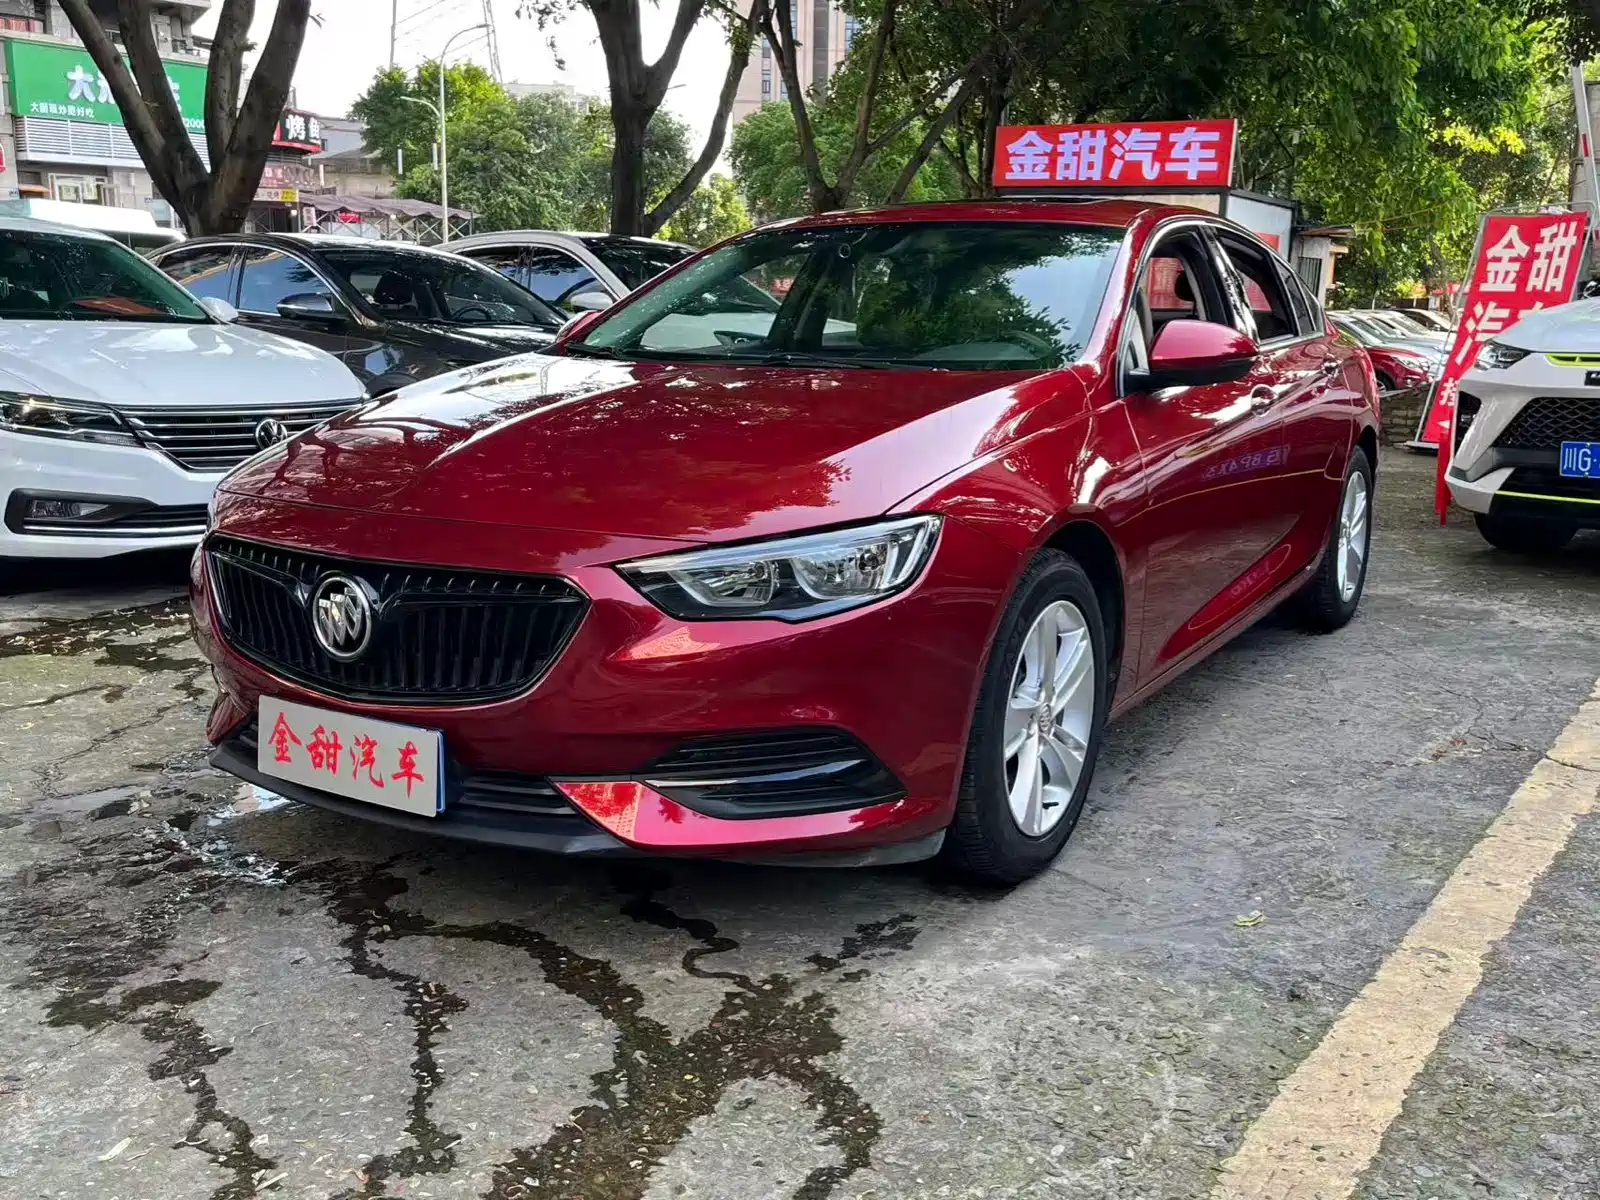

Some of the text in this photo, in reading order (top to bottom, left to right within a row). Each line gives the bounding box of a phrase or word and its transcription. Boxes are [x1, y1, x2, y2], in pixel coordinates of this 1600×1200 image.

[285, 114, 321, 145] 烤鱼
[1005, 127, 1220, 180] 金甜汽车
[1479, 221, 1578, 293] 金甜
[268, 711, 424, 798] 金甜汽车
